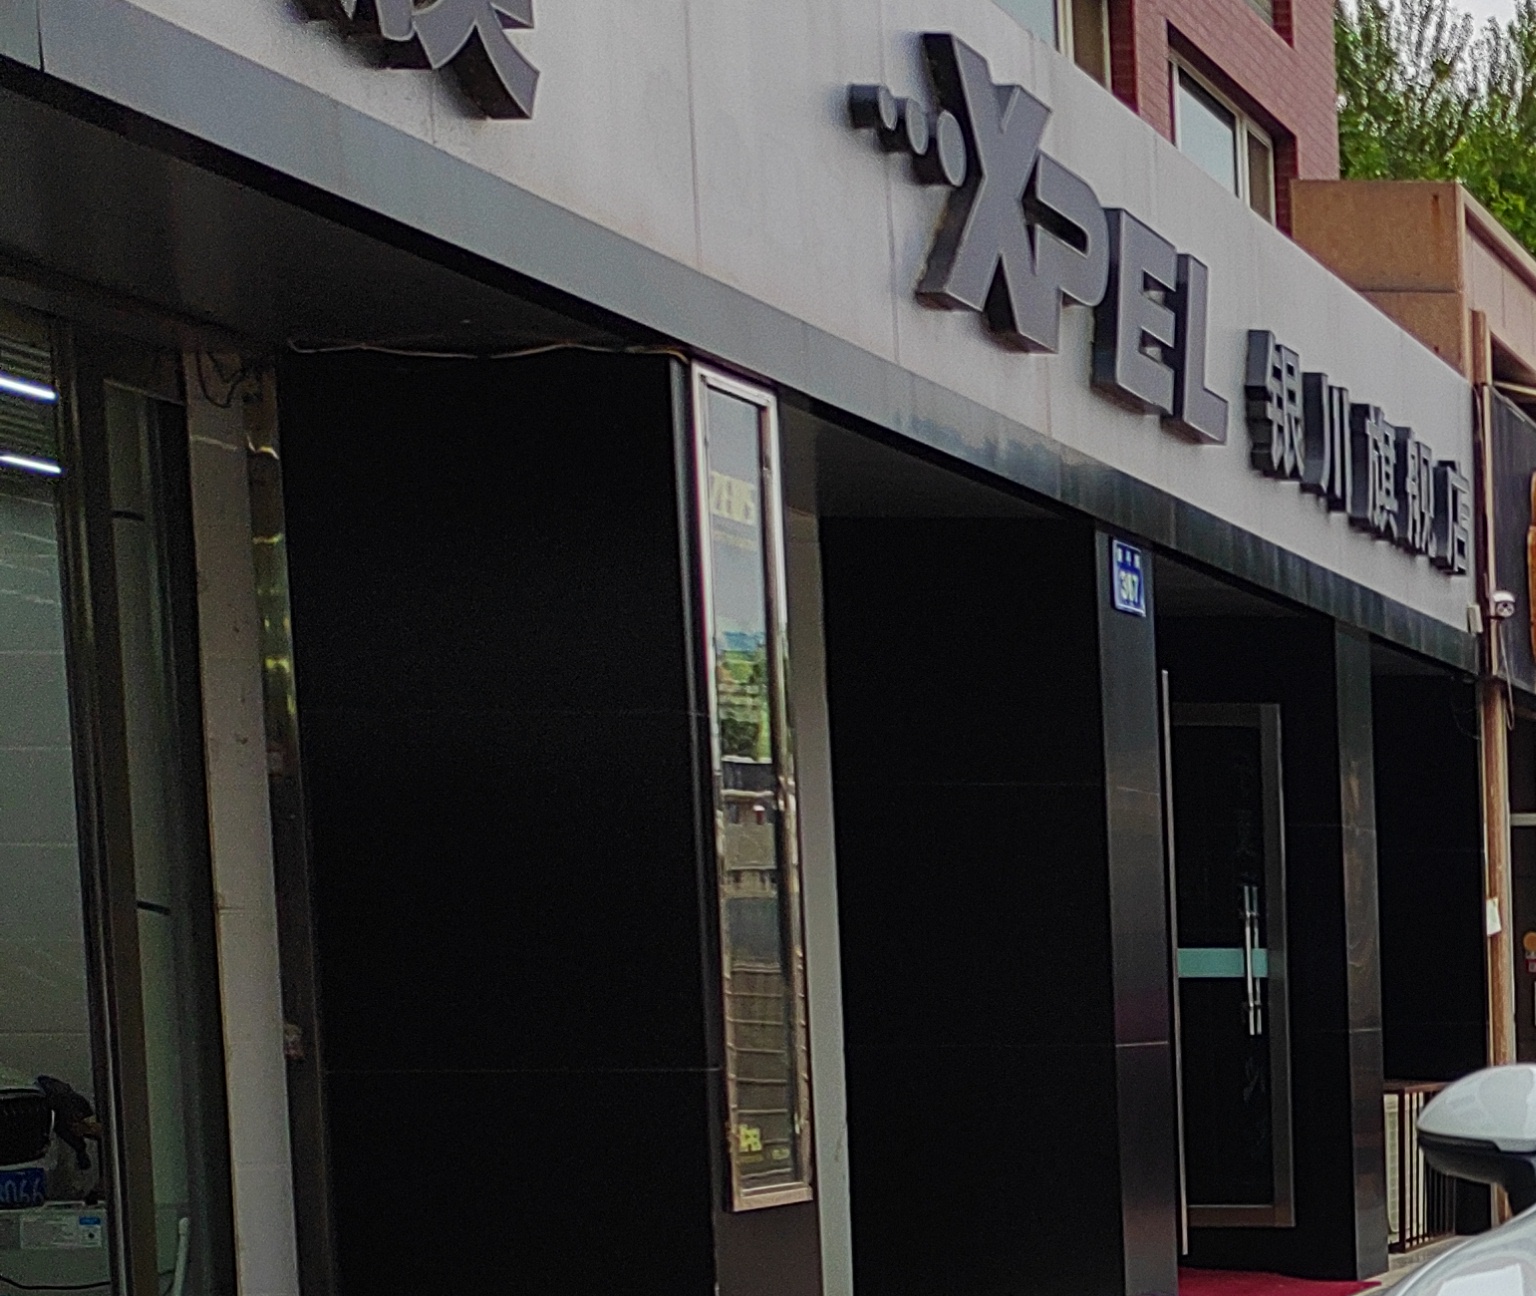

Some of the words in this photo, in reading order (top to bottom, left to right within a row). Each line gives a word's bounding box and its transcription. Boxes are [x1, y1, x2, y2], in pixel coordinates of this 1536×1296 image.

[914, 33, 1229, 446] XPEL
[1245, 329, 1471, 576] 银川旗舰店
